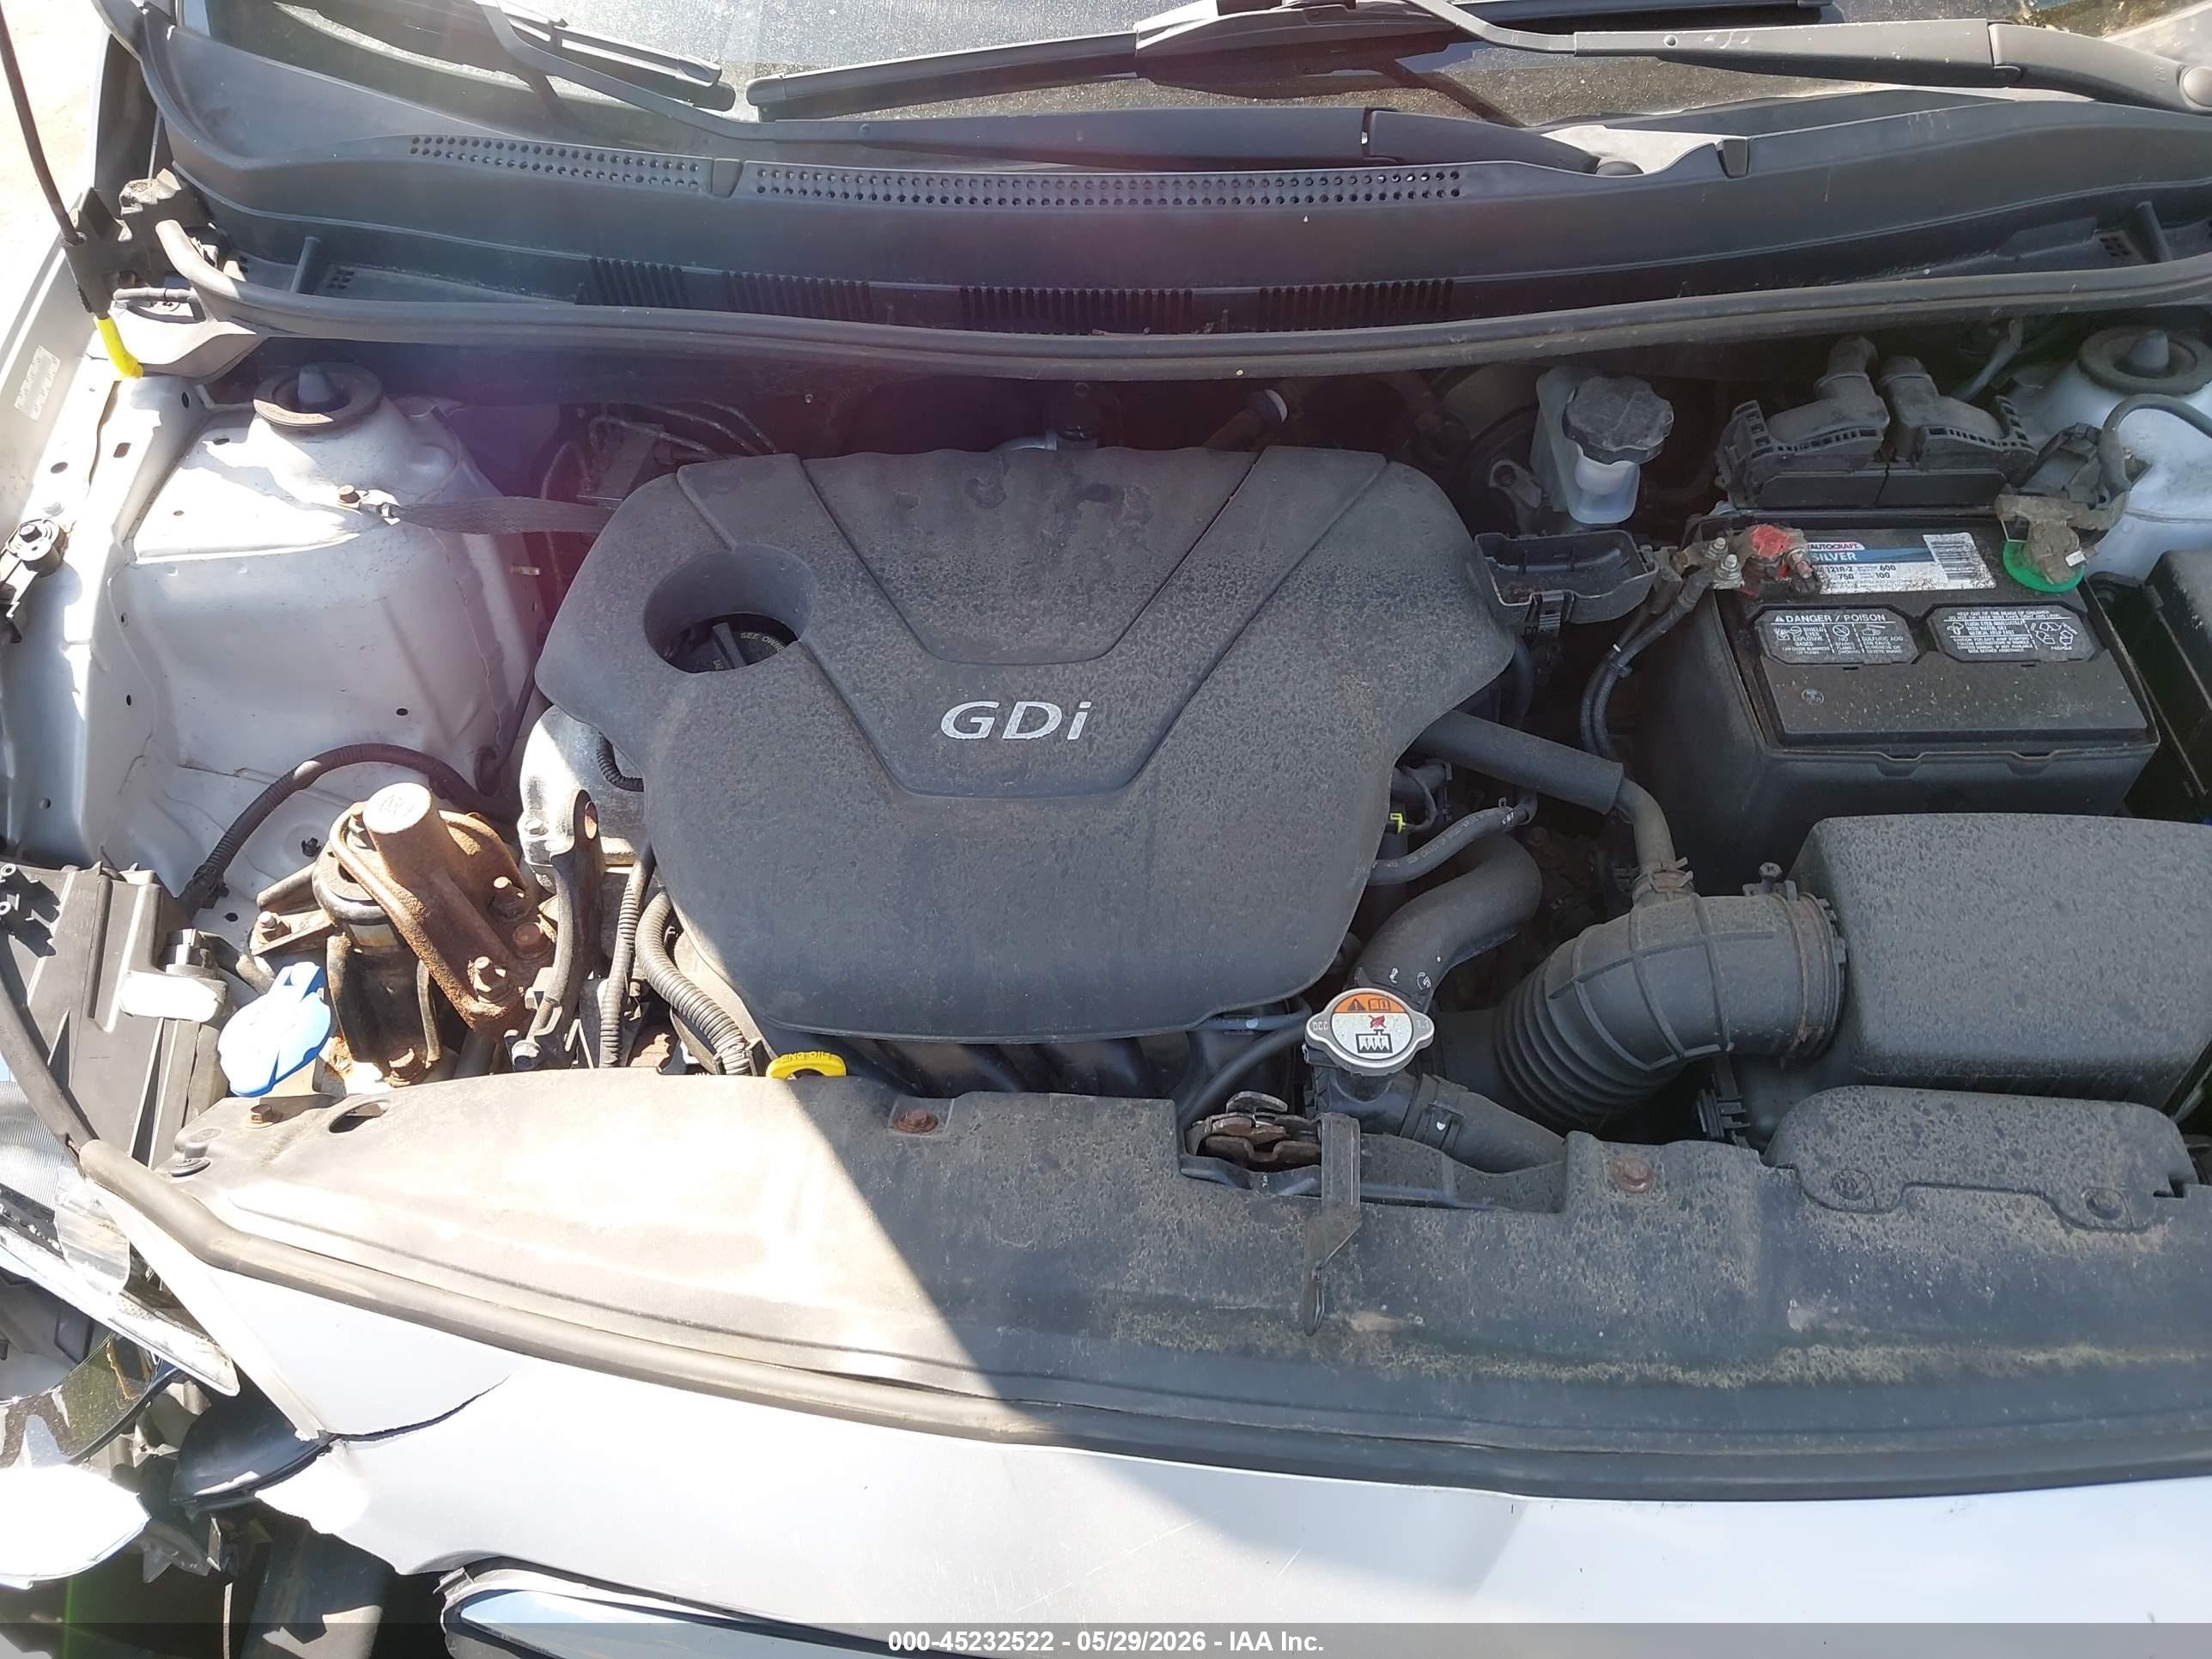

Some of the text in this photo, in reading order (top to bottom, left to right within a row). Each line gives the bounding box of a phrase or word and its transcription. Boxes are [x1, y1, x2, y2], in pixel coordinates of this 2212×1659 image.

[1811, 551, 1857, 561] SILVER
[1785, 614, 1832, 623] DANGER
[1844, 613, 1886, 622] POISON
[941, 701, 1092, 740] GDi
[781, 1052, 806, 1064] ENG
